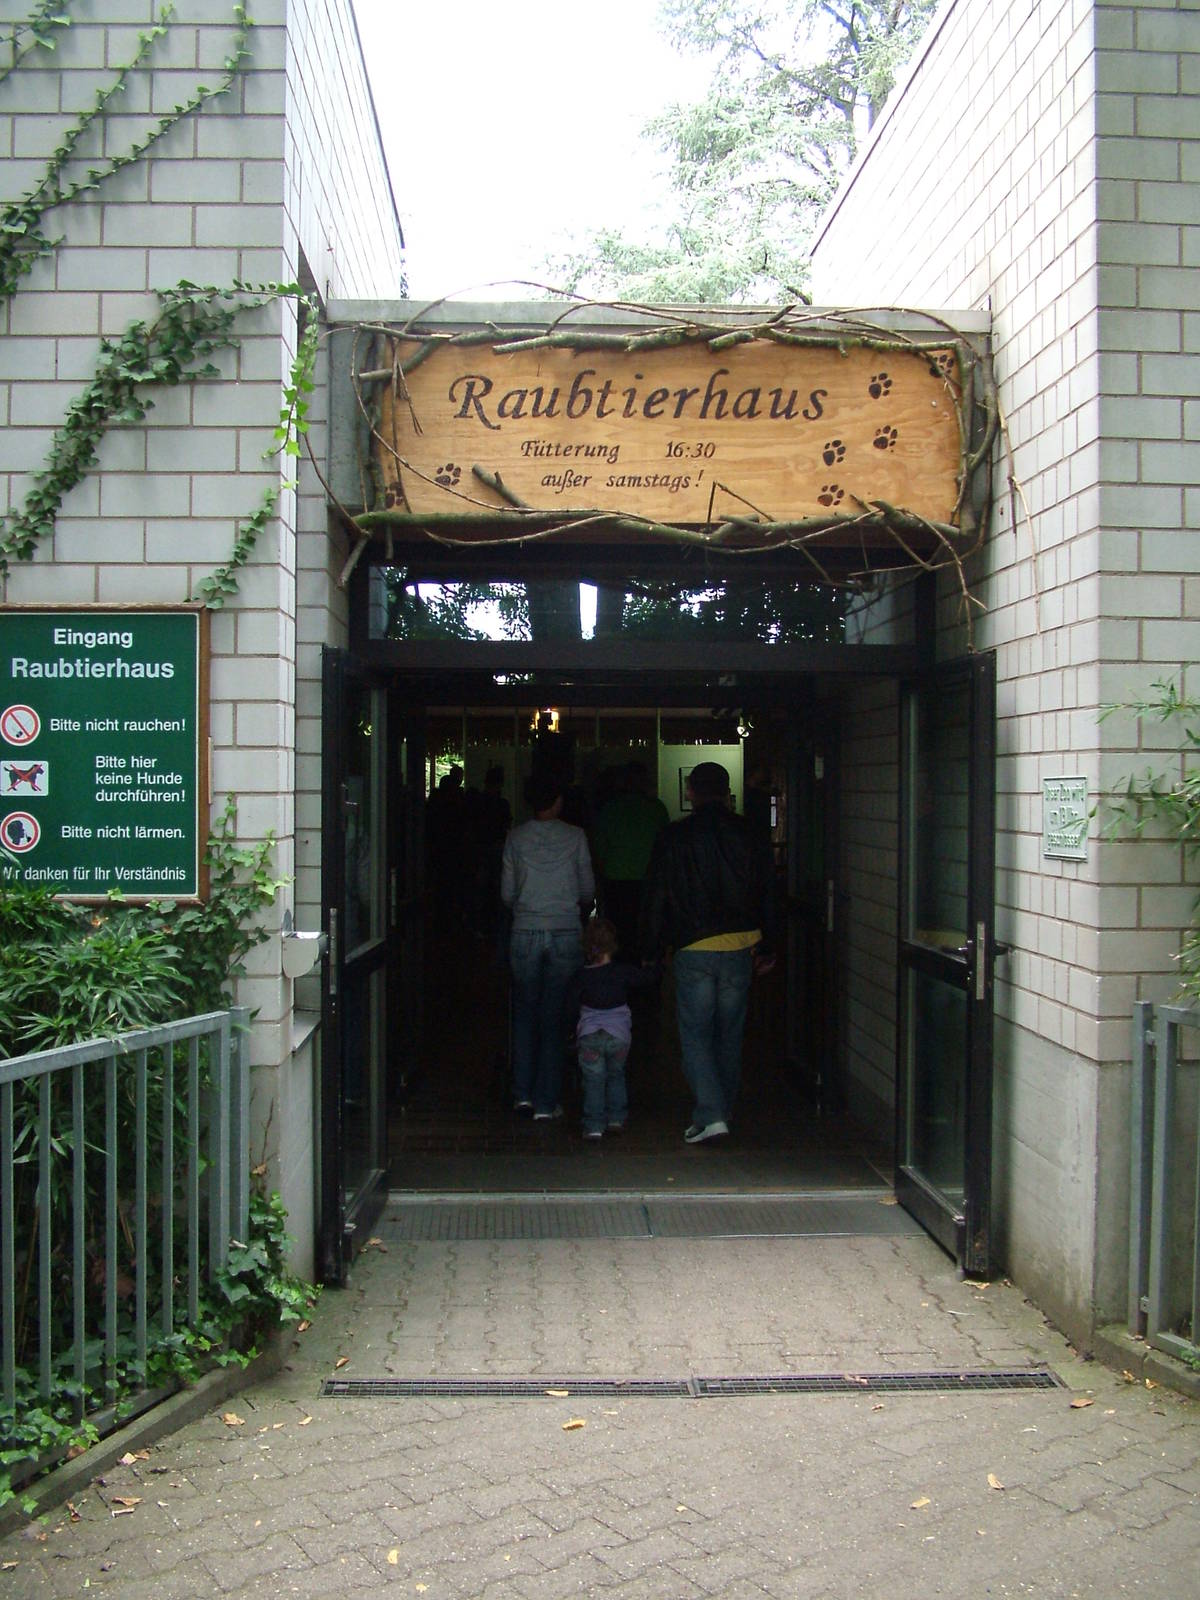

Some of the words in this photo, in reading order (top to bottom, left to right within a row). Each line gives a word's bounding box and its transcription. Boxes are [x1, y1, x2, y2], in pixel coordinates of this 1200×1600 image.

[448, 367, 828, 431] Raubtierhaus
[520, 439, 621, 465] Fütterung
[665, 441, 716, 458] 16:30
[541, 469, 593, 495] außer
[53, 628, 133, 649] Eingang
[11, 657, 175, 679] Raubtierhaus
[50, 718, 81, 732] Bitte
[85, 718, 120, 732] nicht
[123, 718, 186, 732] rauchen!
[95, 755, 127, 769] Bitte
[130, 755, 158, 769] hier
[95, 771, 133, 785] keine
[136, 771, 183, 785] Hunde
[95, 788, 186, 803] durchführen!
[61, 825, 93, 839] Bitte
[96, 825, 131, 839] nicht
[134, 825, 186, 839] lärmen.
[24, 866, 69, 881] danken
[73, 866, 91, 880] für
[94, 866, 111, 880] Ihr
[114, 866, 186, 881] Verständnis
